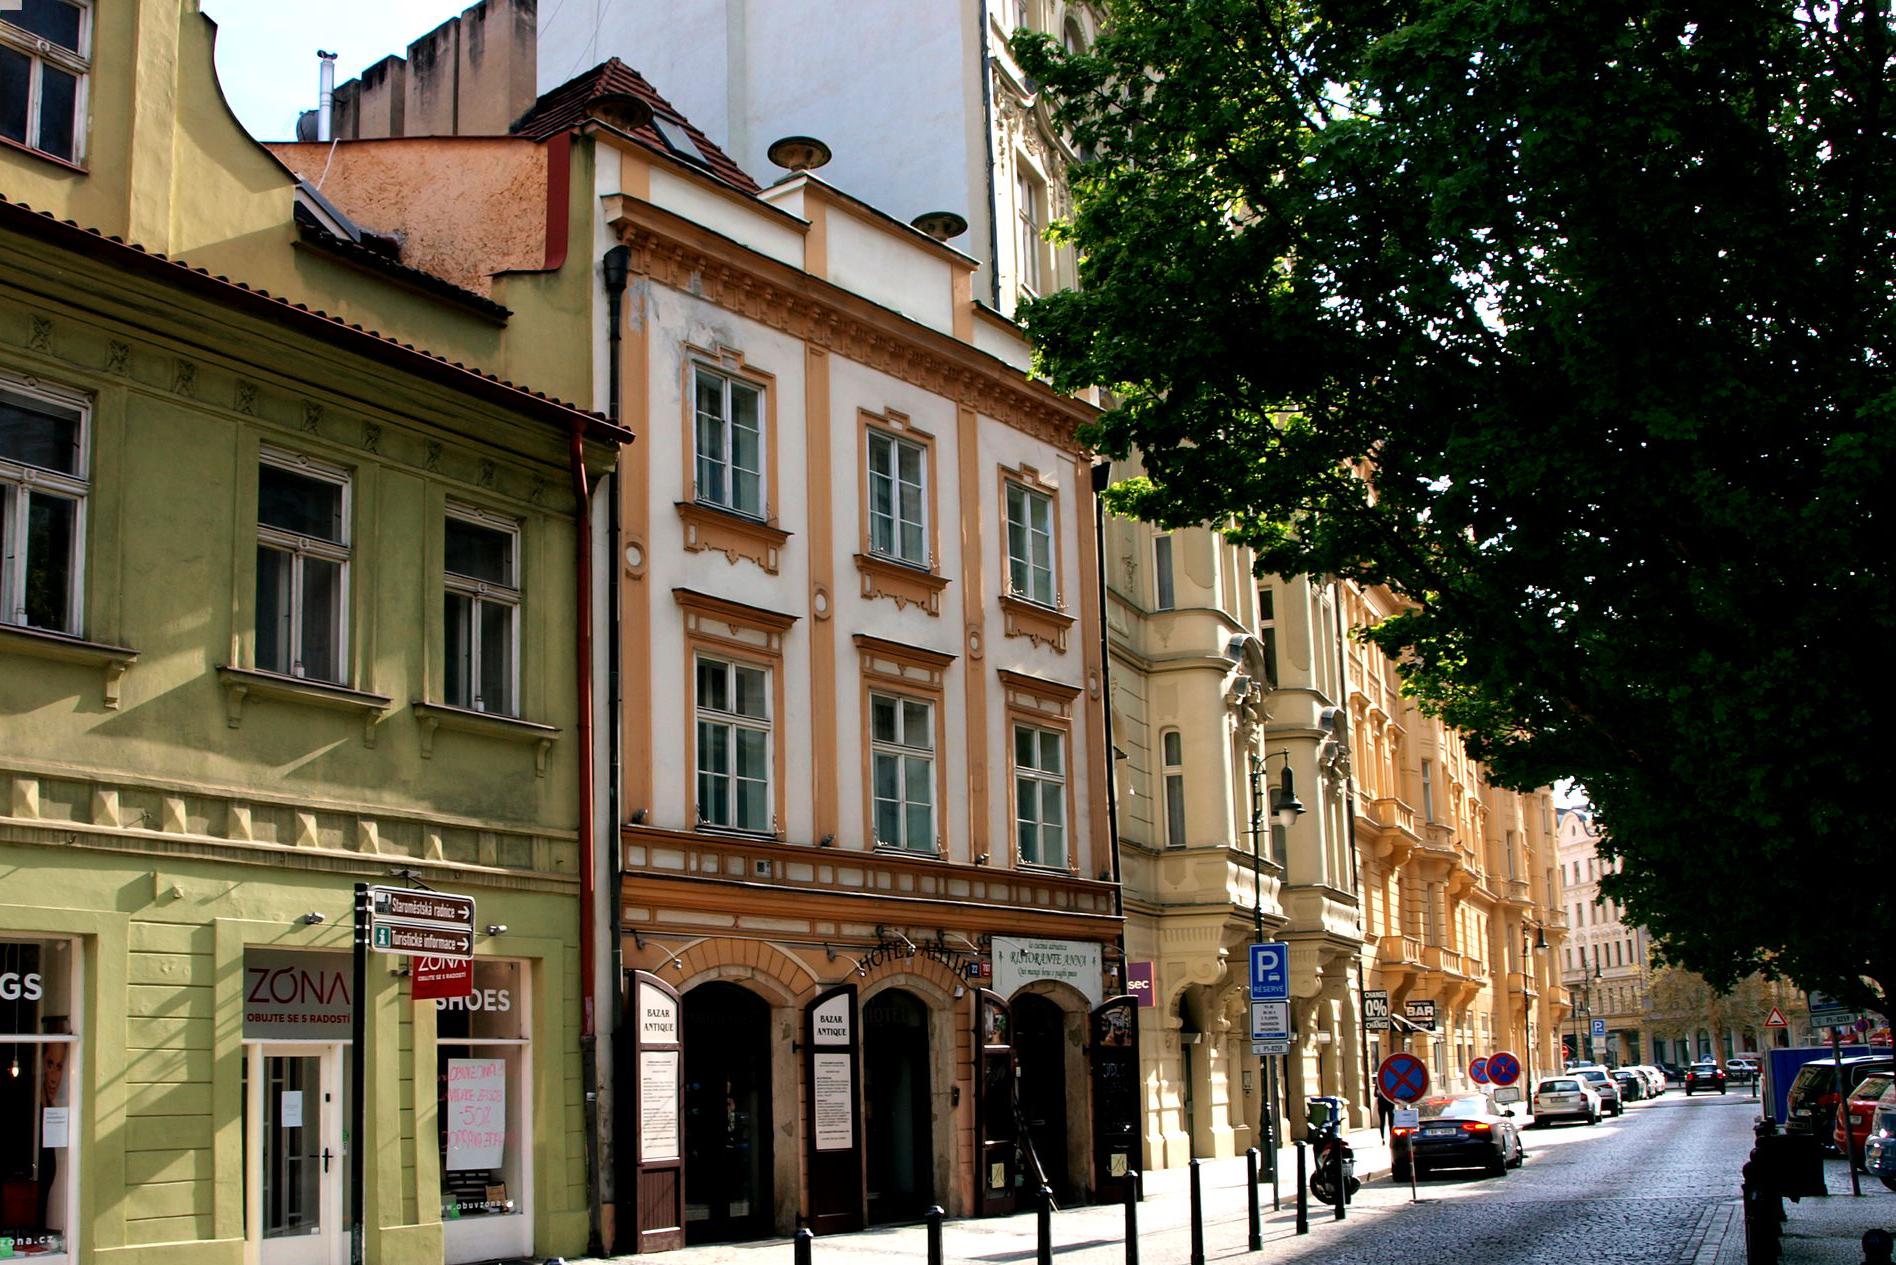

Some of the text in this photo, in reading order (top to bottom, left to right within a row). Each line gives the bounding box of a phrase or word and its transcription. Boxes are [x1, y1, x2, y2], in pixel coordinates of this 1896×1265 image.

[434, 903, 455, 918] radnice
[392, 930, 456, 950] Turistické informace
[1010, 951, 1087, 967] RISTORANTE ANNA
[1257, 951, 1279, 982] P
[1365, 991, 1387, 999] CHANGE
[647, 1009, 670, 1018] BAZAR
[1406, 1005, 1434, 1017] BAR
[246, 1013, 351, 1024] OBUJTE SE S RADOSTÍ
[820, 1015, 843, 1024] BAZAR
[643, 1022, 674, 1032] ANTIQUE
[816, 1027, 847, 1037] ANTIQUE
[1594, 1021, 1603, 1032] P
